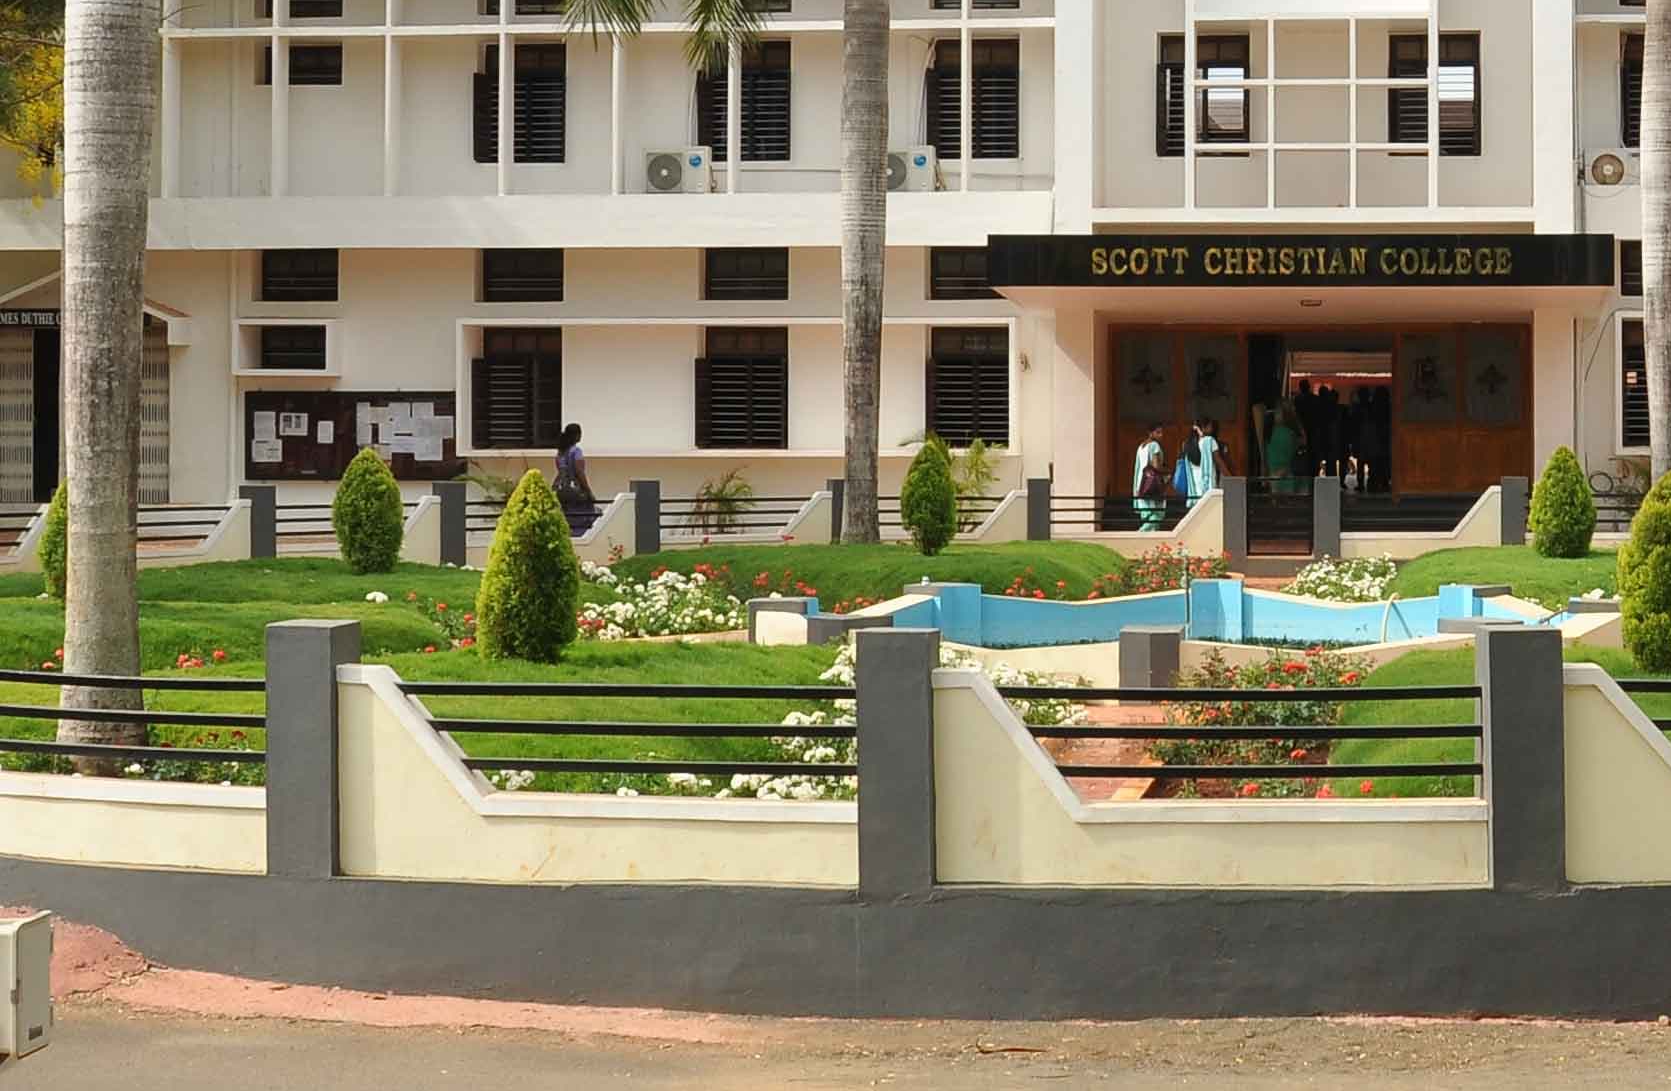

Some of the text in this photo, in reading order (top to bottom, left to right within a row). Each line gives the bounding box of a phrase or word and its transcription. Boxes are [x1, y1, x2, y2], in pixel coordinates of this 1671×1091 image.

[1090, 247, 1513, 275] SCOTT CHRISTIAN COLLEGE
[21, 311, 55, 325] DUTHIE
